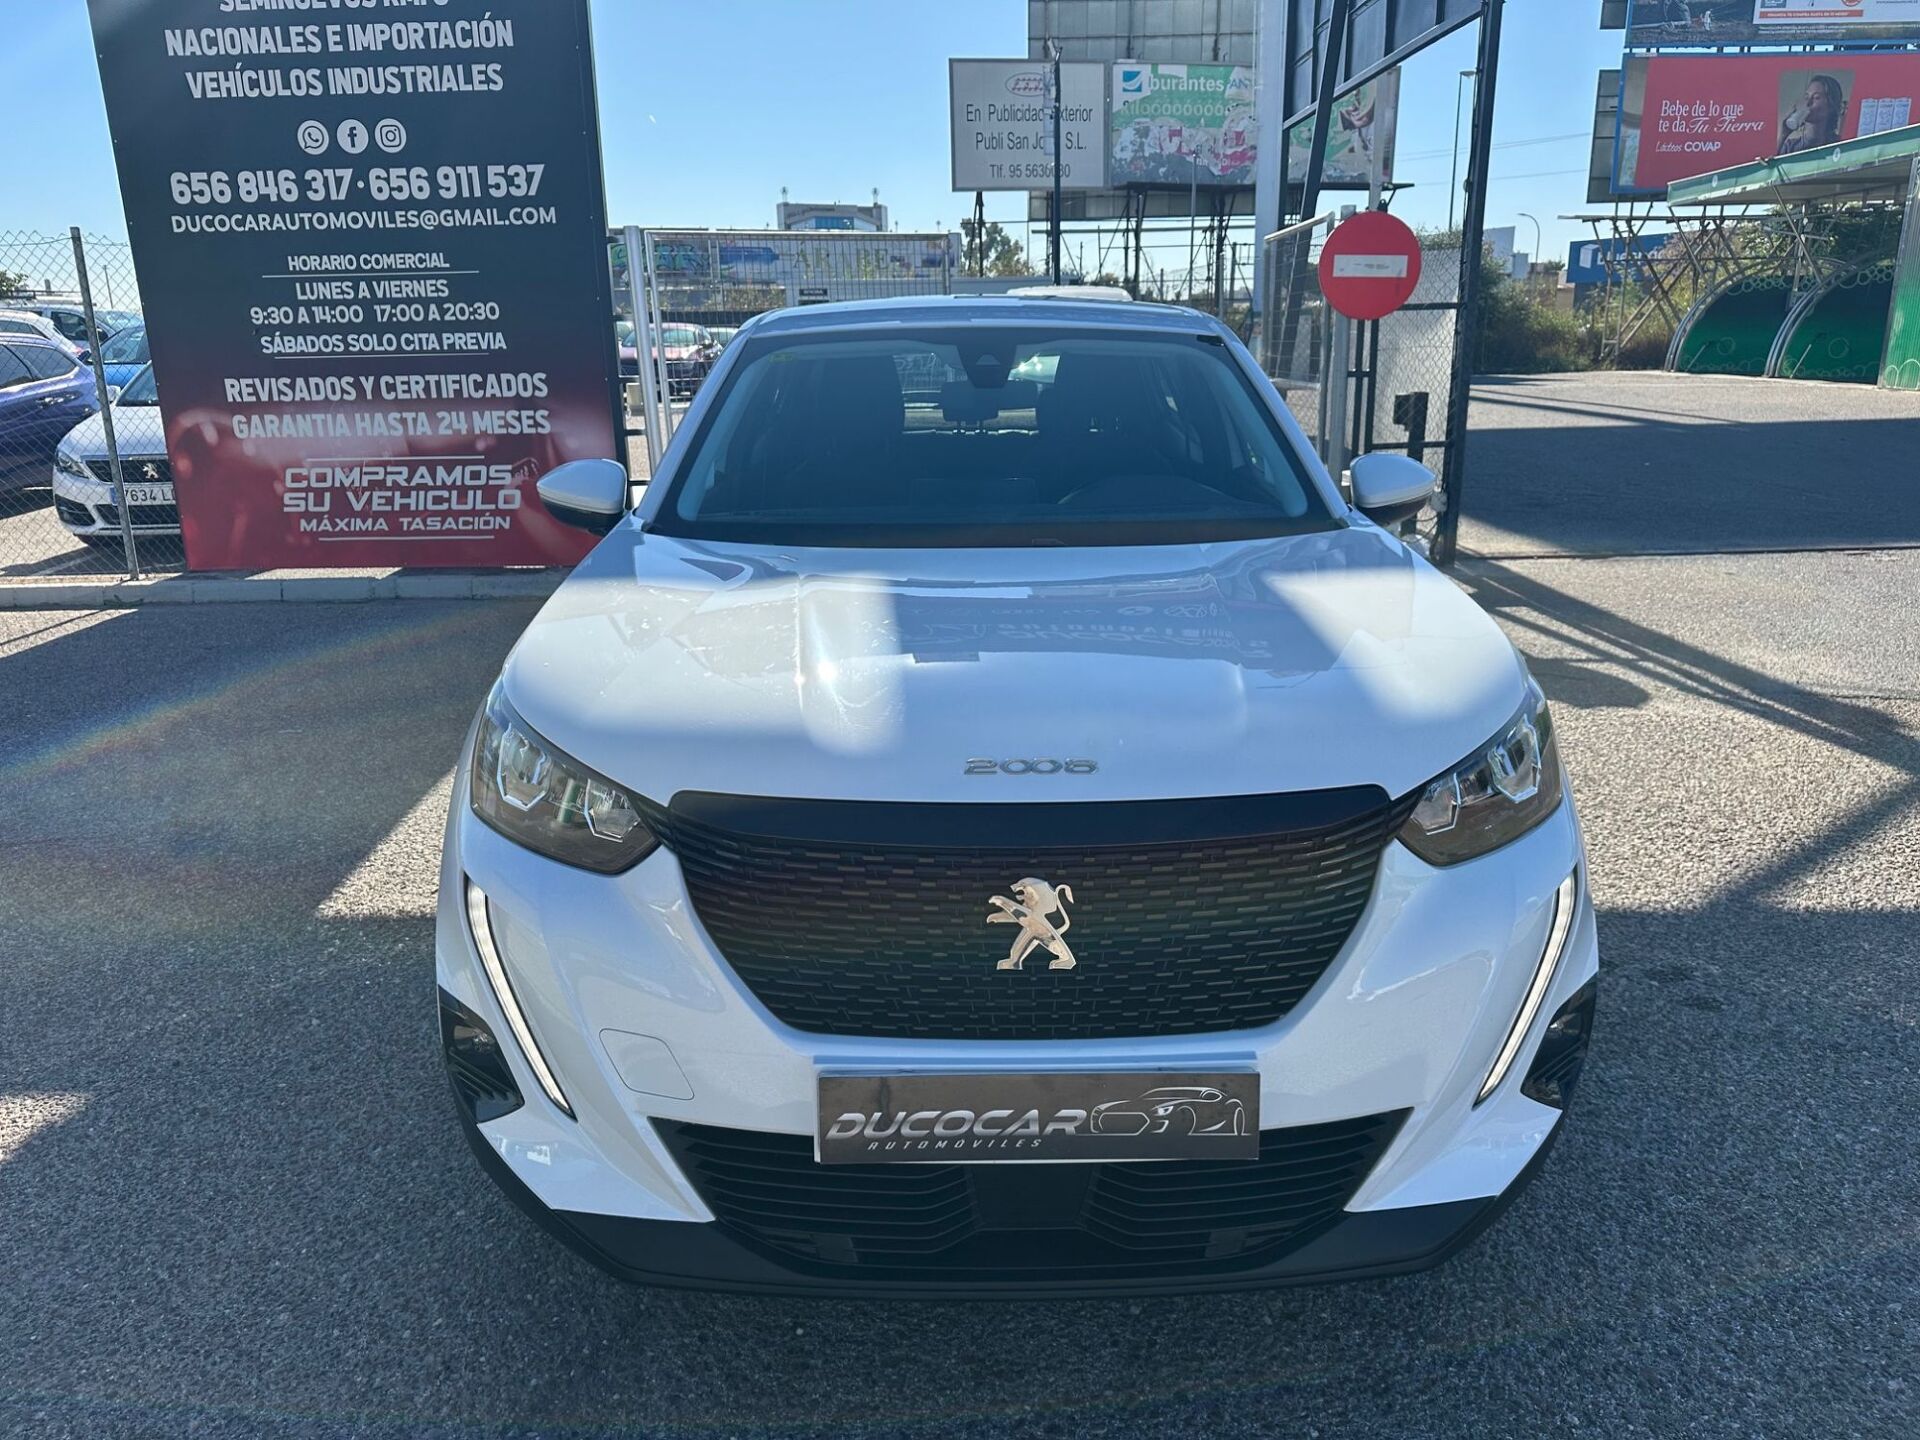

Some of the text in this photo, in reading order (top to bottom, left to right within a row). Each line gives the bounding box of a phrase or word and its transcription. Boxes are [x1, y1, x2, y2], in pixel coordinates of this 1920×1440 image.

[164, 11, 515, 57] NACIONALES E IMPORTACIÓN
[185, 62, 504, 99] VEHÍCULOS INDUSTRIALES
[966, 103, 981, 122] En
[1060, 104, 1093, 122] xterior
[1661, 99, 1744, 118] Bebe de lo que
[1658, 118, 1670, 132] te
[1672, 115, 1686, 132] da
[1713, 115, 1765, 133] Tierra
[975, 132, 1004, 150] Publi
[1007, 131, 1029, 150] San
[1065, 131, 1087, 150] S.L.
[1684, 141, 1721, 152] COVAP
[1008, 163, 1022, 178] 95
[170, 171, 232, 205] 656
[238, 169, 298, 203] 846
[437, 164, 482, 199] 911
[487, 163, 546, 197] 537
[171, 206, 557, 233] DUCOCARAUTOMOVILES@GMAIL.COM
[287, 252, 450, 272] HORARIO COMERCIAL
[295, 279, 449, 301] LUNES A VIERNES
[250, 302, 500, 325] 9:30 A 14:00 17:00 A 20:30
[260, 331, 507, 355] SÁBADOS SOLO CITA PREVIA
[224, 372, 549, 403] REVISADOS Y CERTIFICADOS
[232, 409, 552, 440] GARANTIA HASTA 24 MESES
[284, 464, 514, 490] COMPRAMOS
[283, 489, 522, 514] SU VEHICULO
[299, 512, 511, 533] MÁXIMA TASACIÓN
[964, 757, 1099, 775] 2008
[825, 1108, 1088, 1140] DUCOCAR
